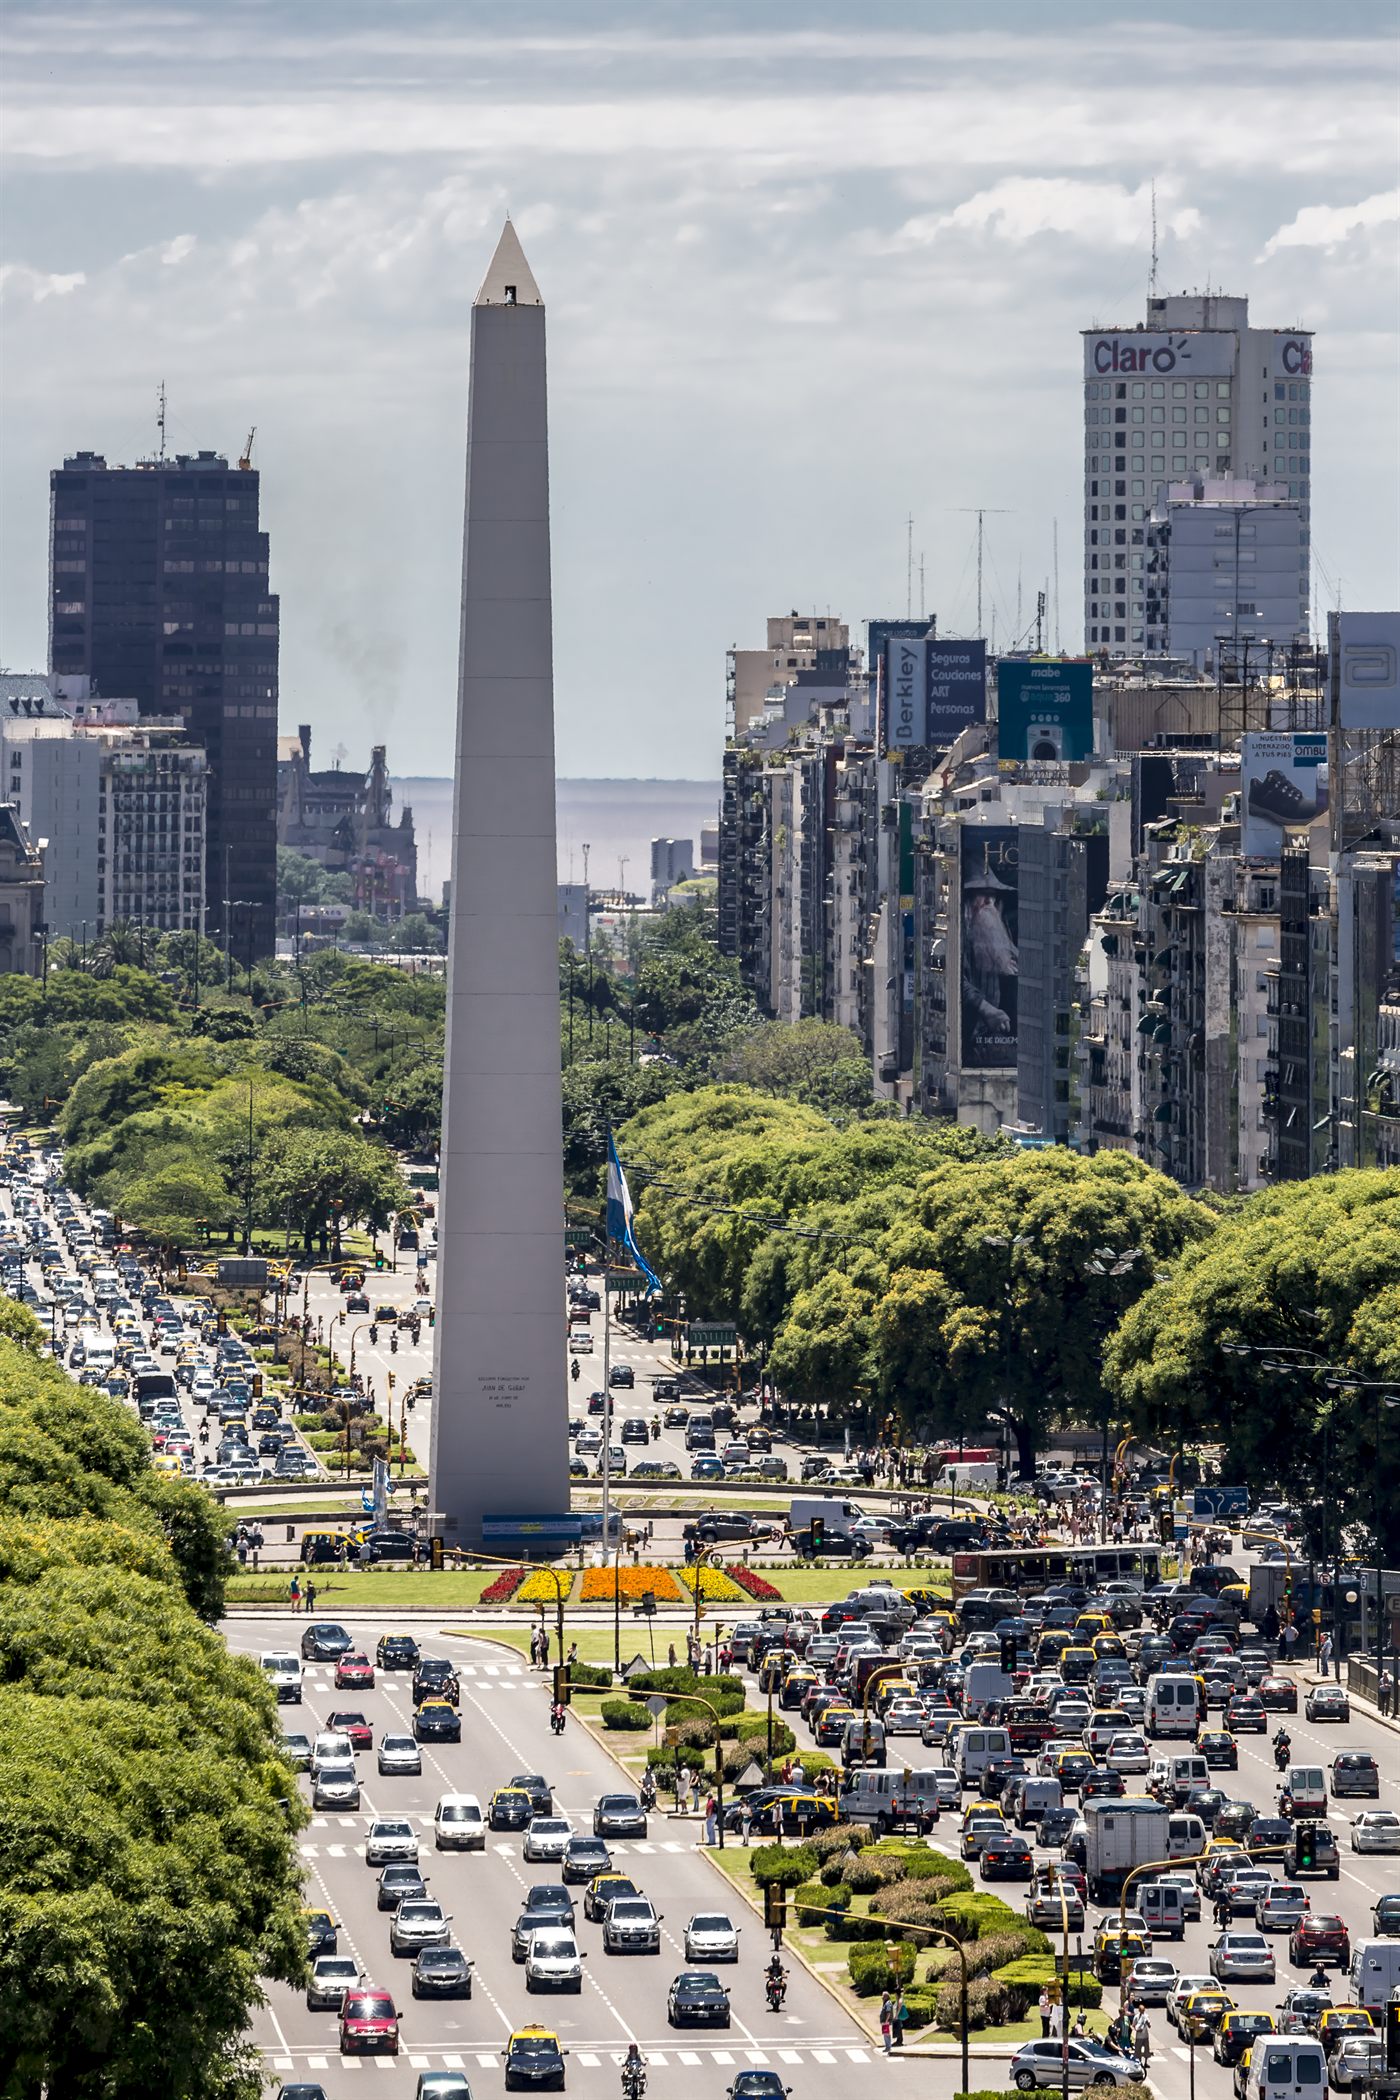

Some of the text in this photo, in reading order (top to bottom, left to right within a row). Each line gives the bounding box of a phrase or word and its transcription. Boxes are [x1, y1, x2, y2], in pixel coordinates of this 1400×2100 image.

[1094, 339, 1176, 374] Claro
[930, 652, 971, 667] Seguros
[931, 668, 982, 681] Cauciones
[1031, 665, 1061, 678] mabe
[896, 645, 918, 739] Berkley
[931, 685, 951, 698] ART
[930, 701, 975, 715] Personas
[1294, 746, 1326, 756] OMBU
